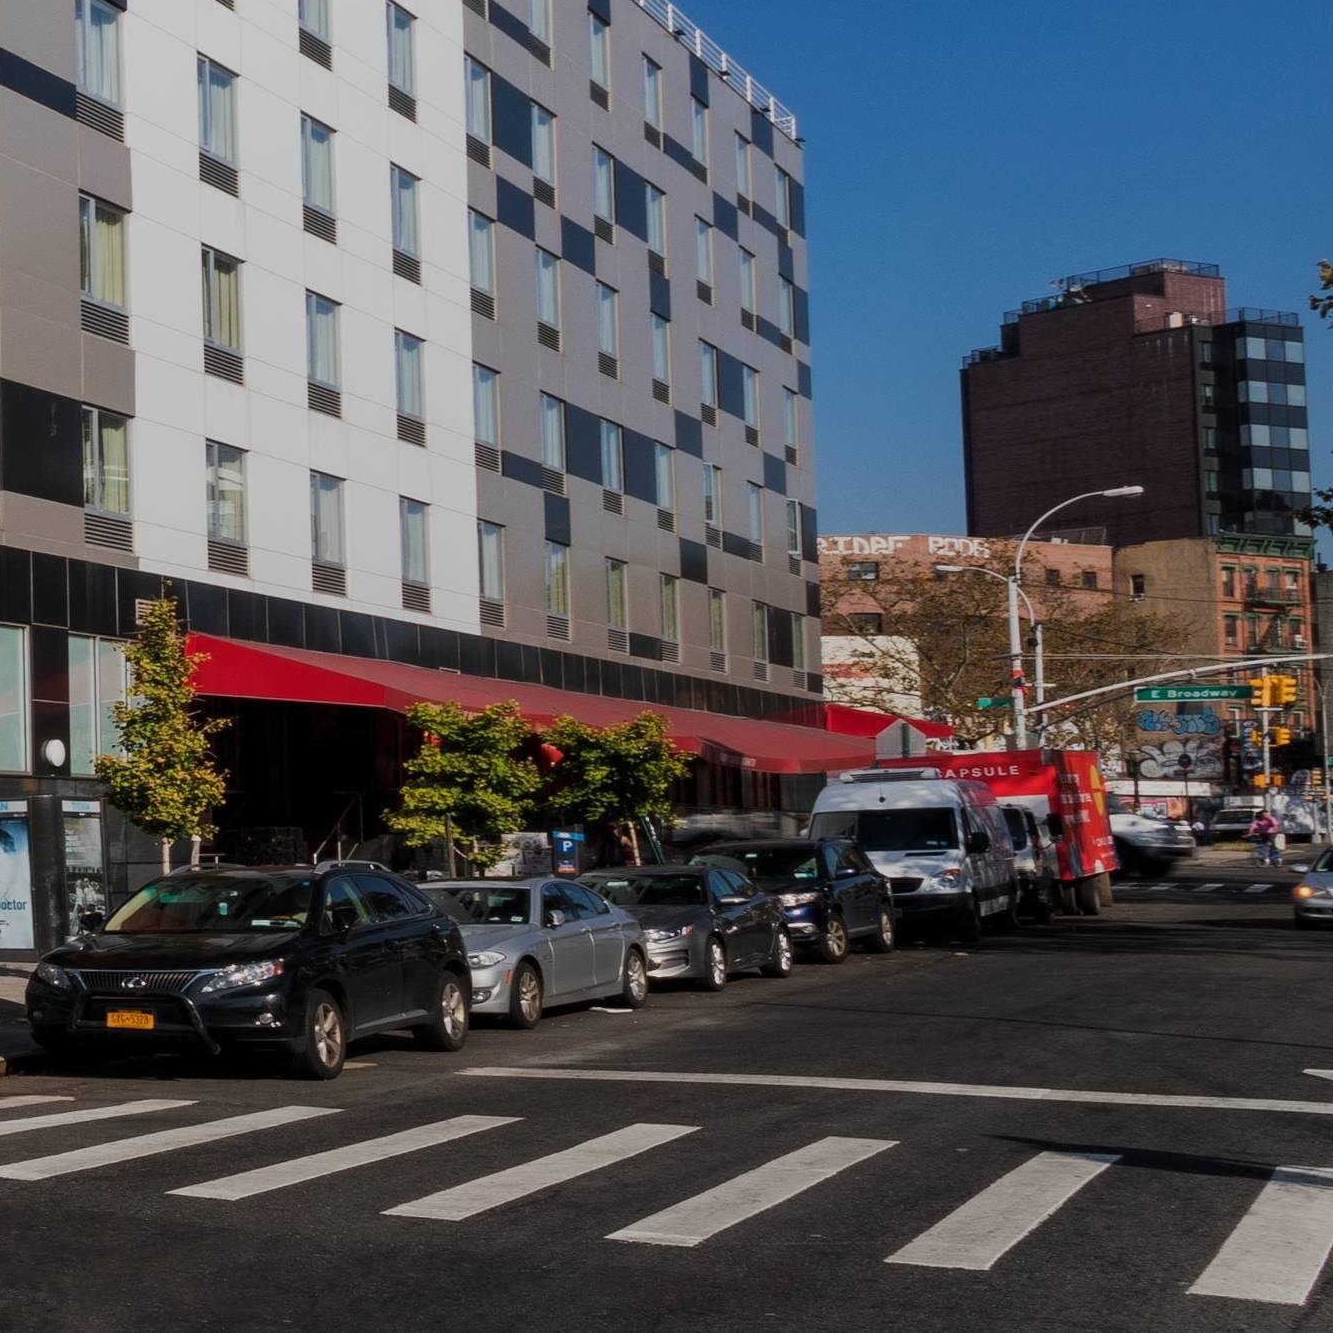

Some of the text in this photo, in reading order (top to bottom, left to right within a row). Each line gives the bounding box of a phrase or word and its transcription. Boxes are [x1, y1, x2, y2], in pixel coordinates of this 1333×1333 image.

[1151, 689, 1237, 698] E Broadway
[562, 840, 573, 853] P
